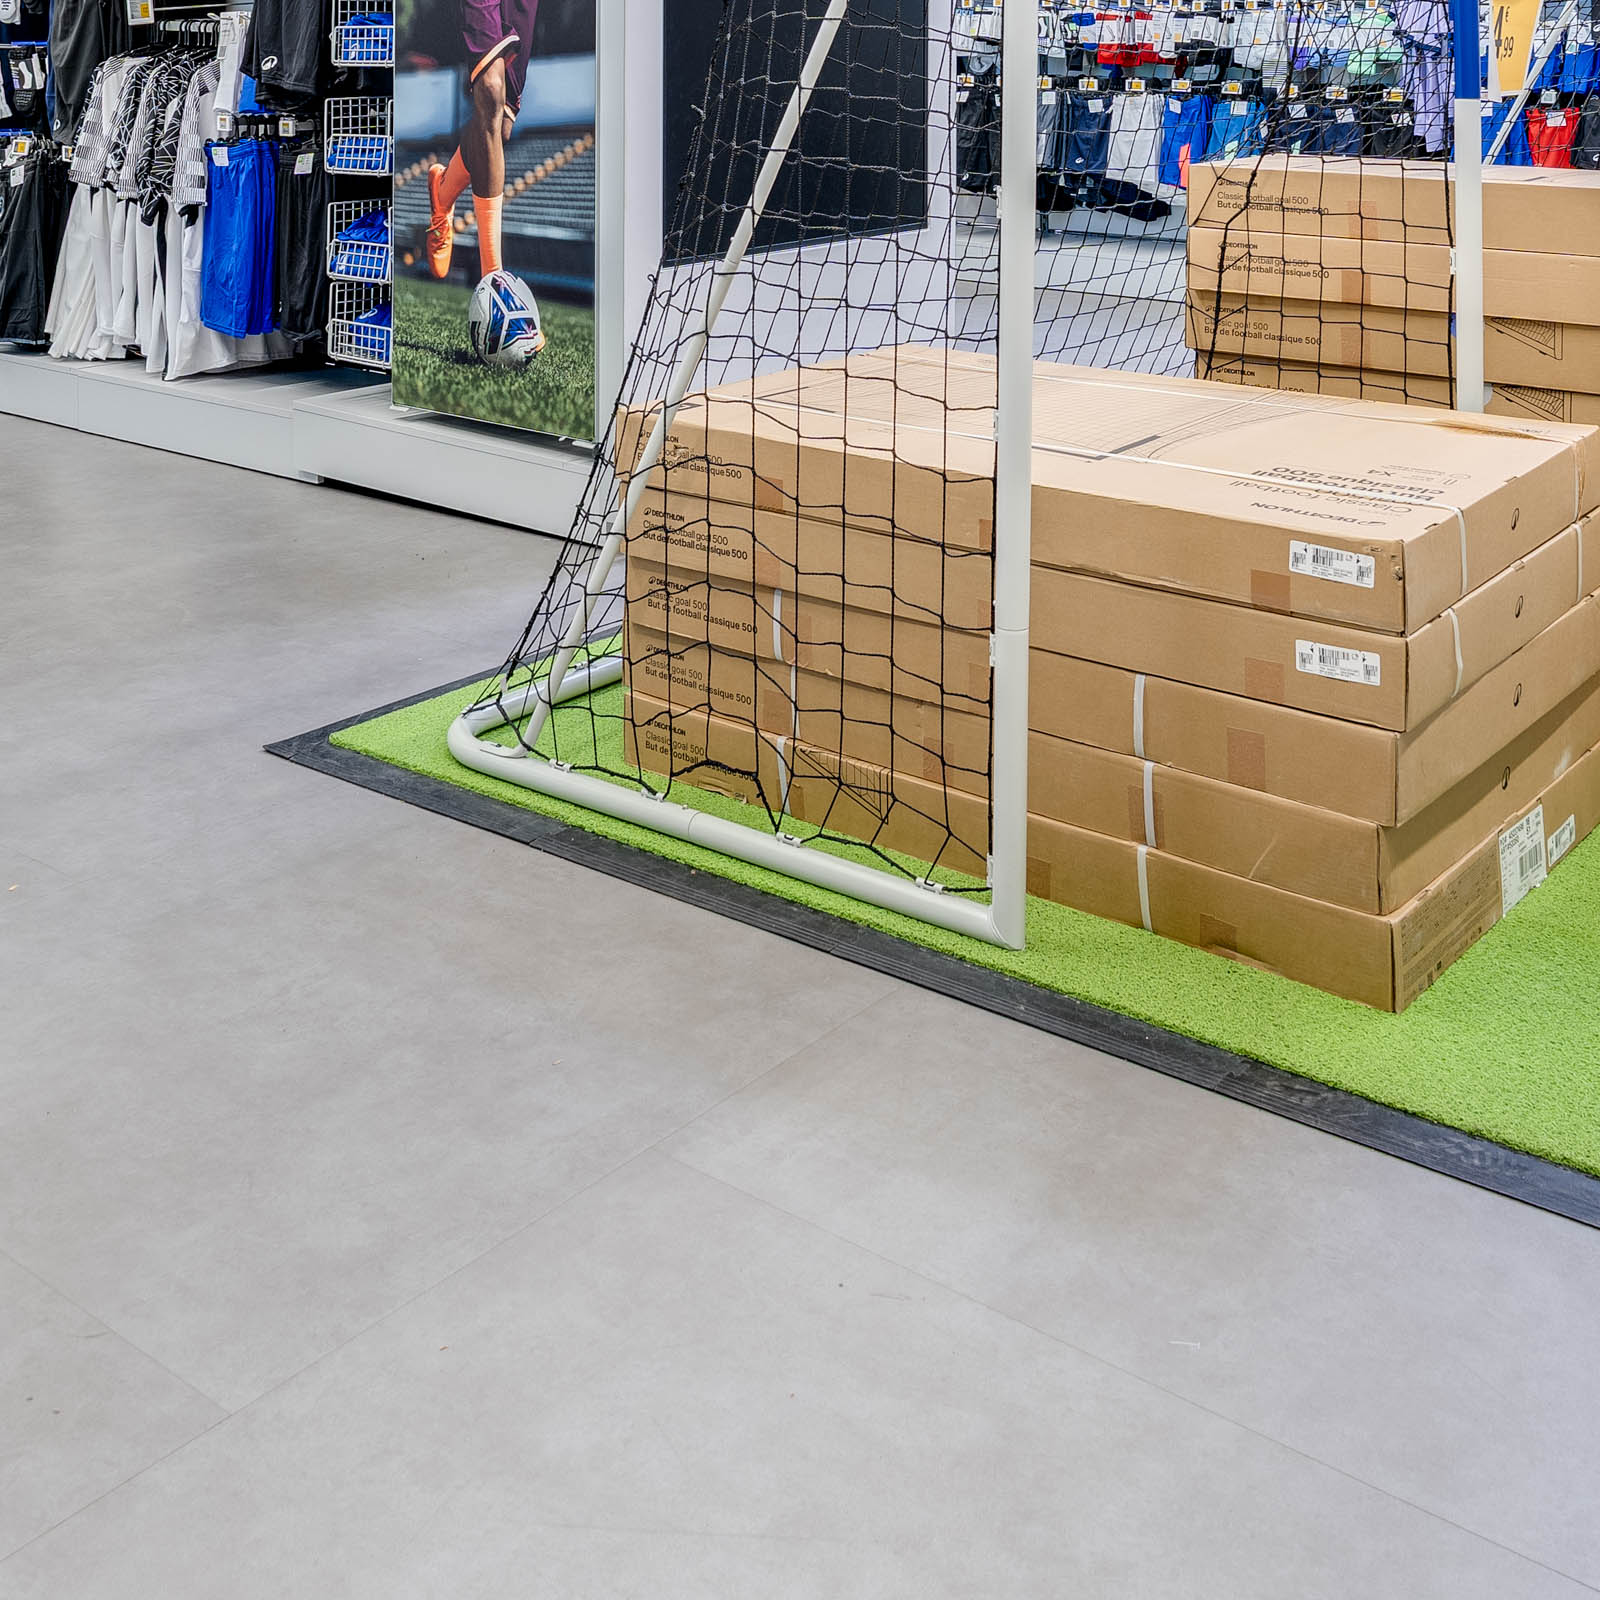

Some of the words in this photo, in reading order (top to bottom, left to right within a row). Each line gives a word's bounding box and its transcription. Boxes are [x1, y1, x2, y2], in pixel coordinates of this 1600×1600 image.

[1217, 191, 1244, 200] Classic
[1246, 194, 1273, 202] ootball
[1292, 196, 1309, 205] 500
[1244, 203, 1273, 211] ootball
[1231, 264, 1242, 272] de
[1253, 322, 1269, 331] 500
[1264, 332, 1303, 344] classique
[725, 468, 742, 479] 500
[1271, 466, 1325, 479] 500
[1228, 480, 1320, 502] football
[1326, 495, 1412, 513] Classic
[1250, 502, 1358, 524] DECATHLON
[712, 534, 728, 546] 500
[695, 542, 730, 556] clasique
[731, 549, 747, 560] 500
[675, 597, 691, 607] goal
[692, 599, 707, 611] 500
[647, 598, 660, 609] But
[673, 603, 701, 620] football
[703, 614, 740, 629] cassique
[672, 665, 687, 676] goal
[688, 669, 702, 681] 500
[645, 666, 657, 677] But
[658, 671, 668, 680] de
[735, 693, 751, 705] 500
[645, 730, 670, 745] Classic
[672, 741, 688, 752] goal
[690, 744, 704, 756] 500
[645, 741, 658, 752] But
[659, 746, 669, 755] de
[671, 749, 699, 764] ootball
